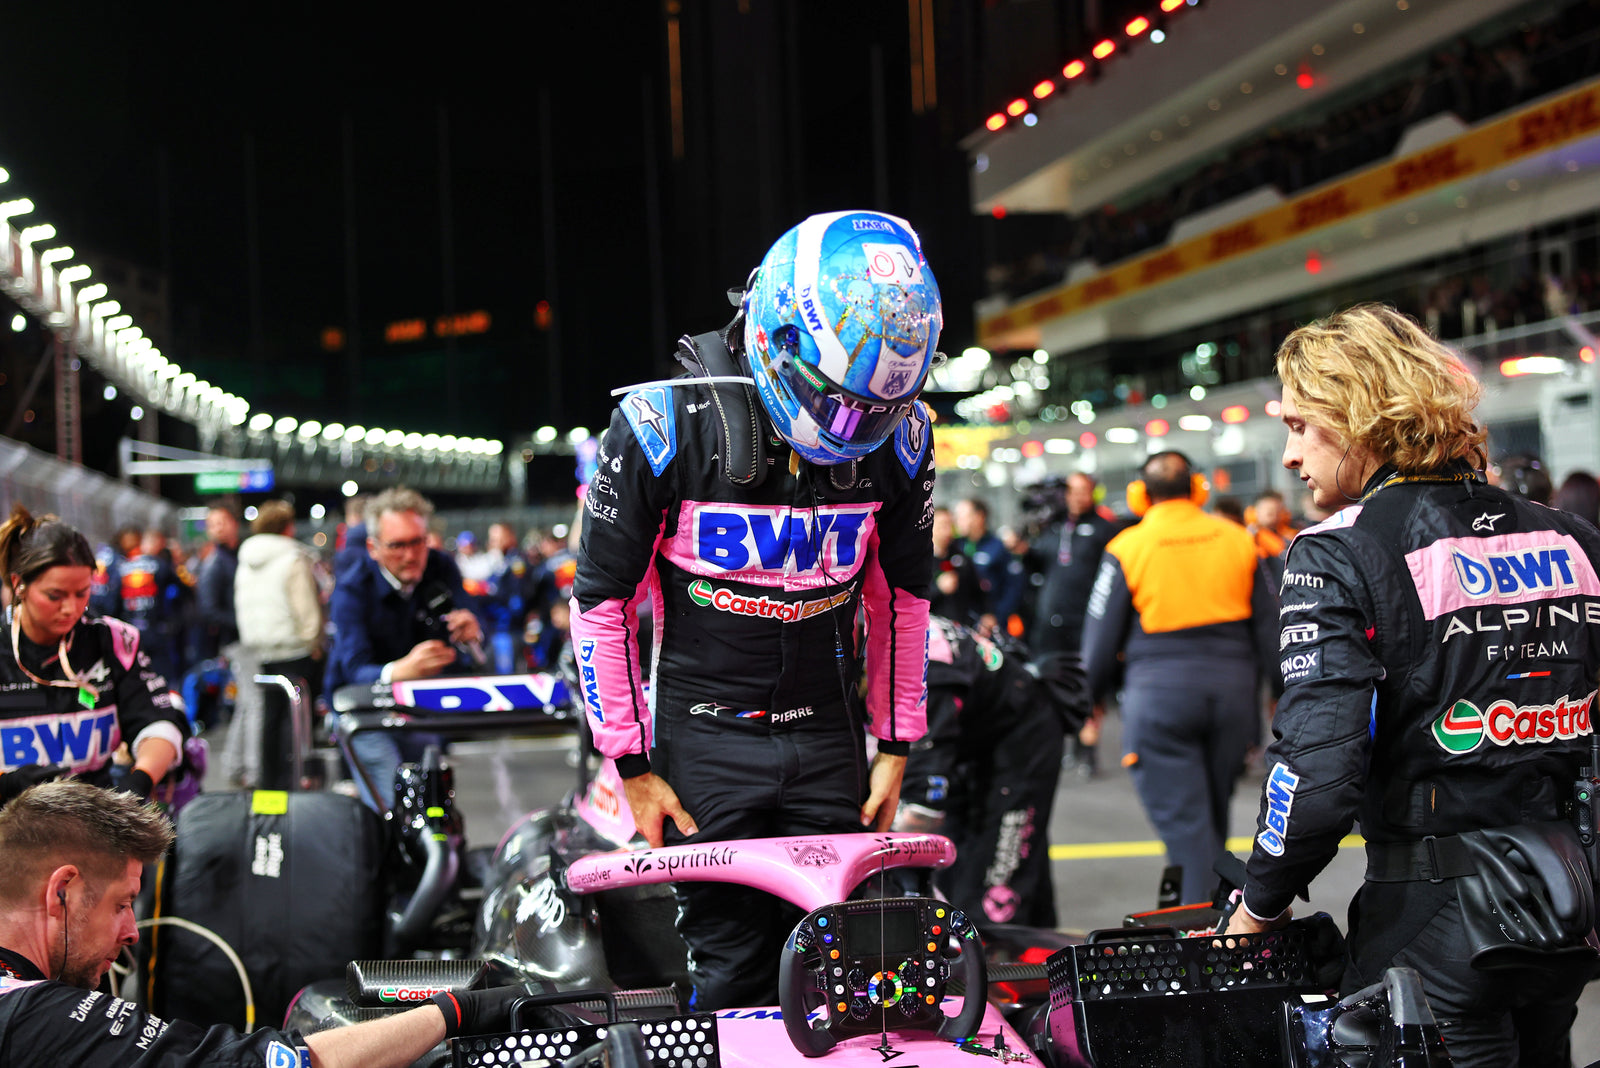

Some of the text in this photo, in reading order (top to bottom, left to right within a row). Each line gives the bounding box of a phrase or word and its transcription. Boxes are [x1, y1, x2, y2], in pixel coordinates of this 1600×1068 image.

[803, 299, 823, 331] BWT
[800, 365, 823, 388] Castrol
[828, 393, 910, 415] ALPIN
[698, 512, 870, 573] BWT
[725, 573, 770, 585] WATER
[1489, 548, 1571, 594] BWT
[714, 590, 800, 622] Castrol
[1442, 602, 1600, 644] ALPINE
[1521, 640, 1569, 659] TEAM
[582, 665, 605, 723] BWT
[771, 705, 814, 724] PIERRE
[1488, 694, 1594, 741] Castrol
[1, 713, 117, 767] BWT
[1265, 765, 1296, 836] BWT
[657, 846, 738, 876] sprinklr
